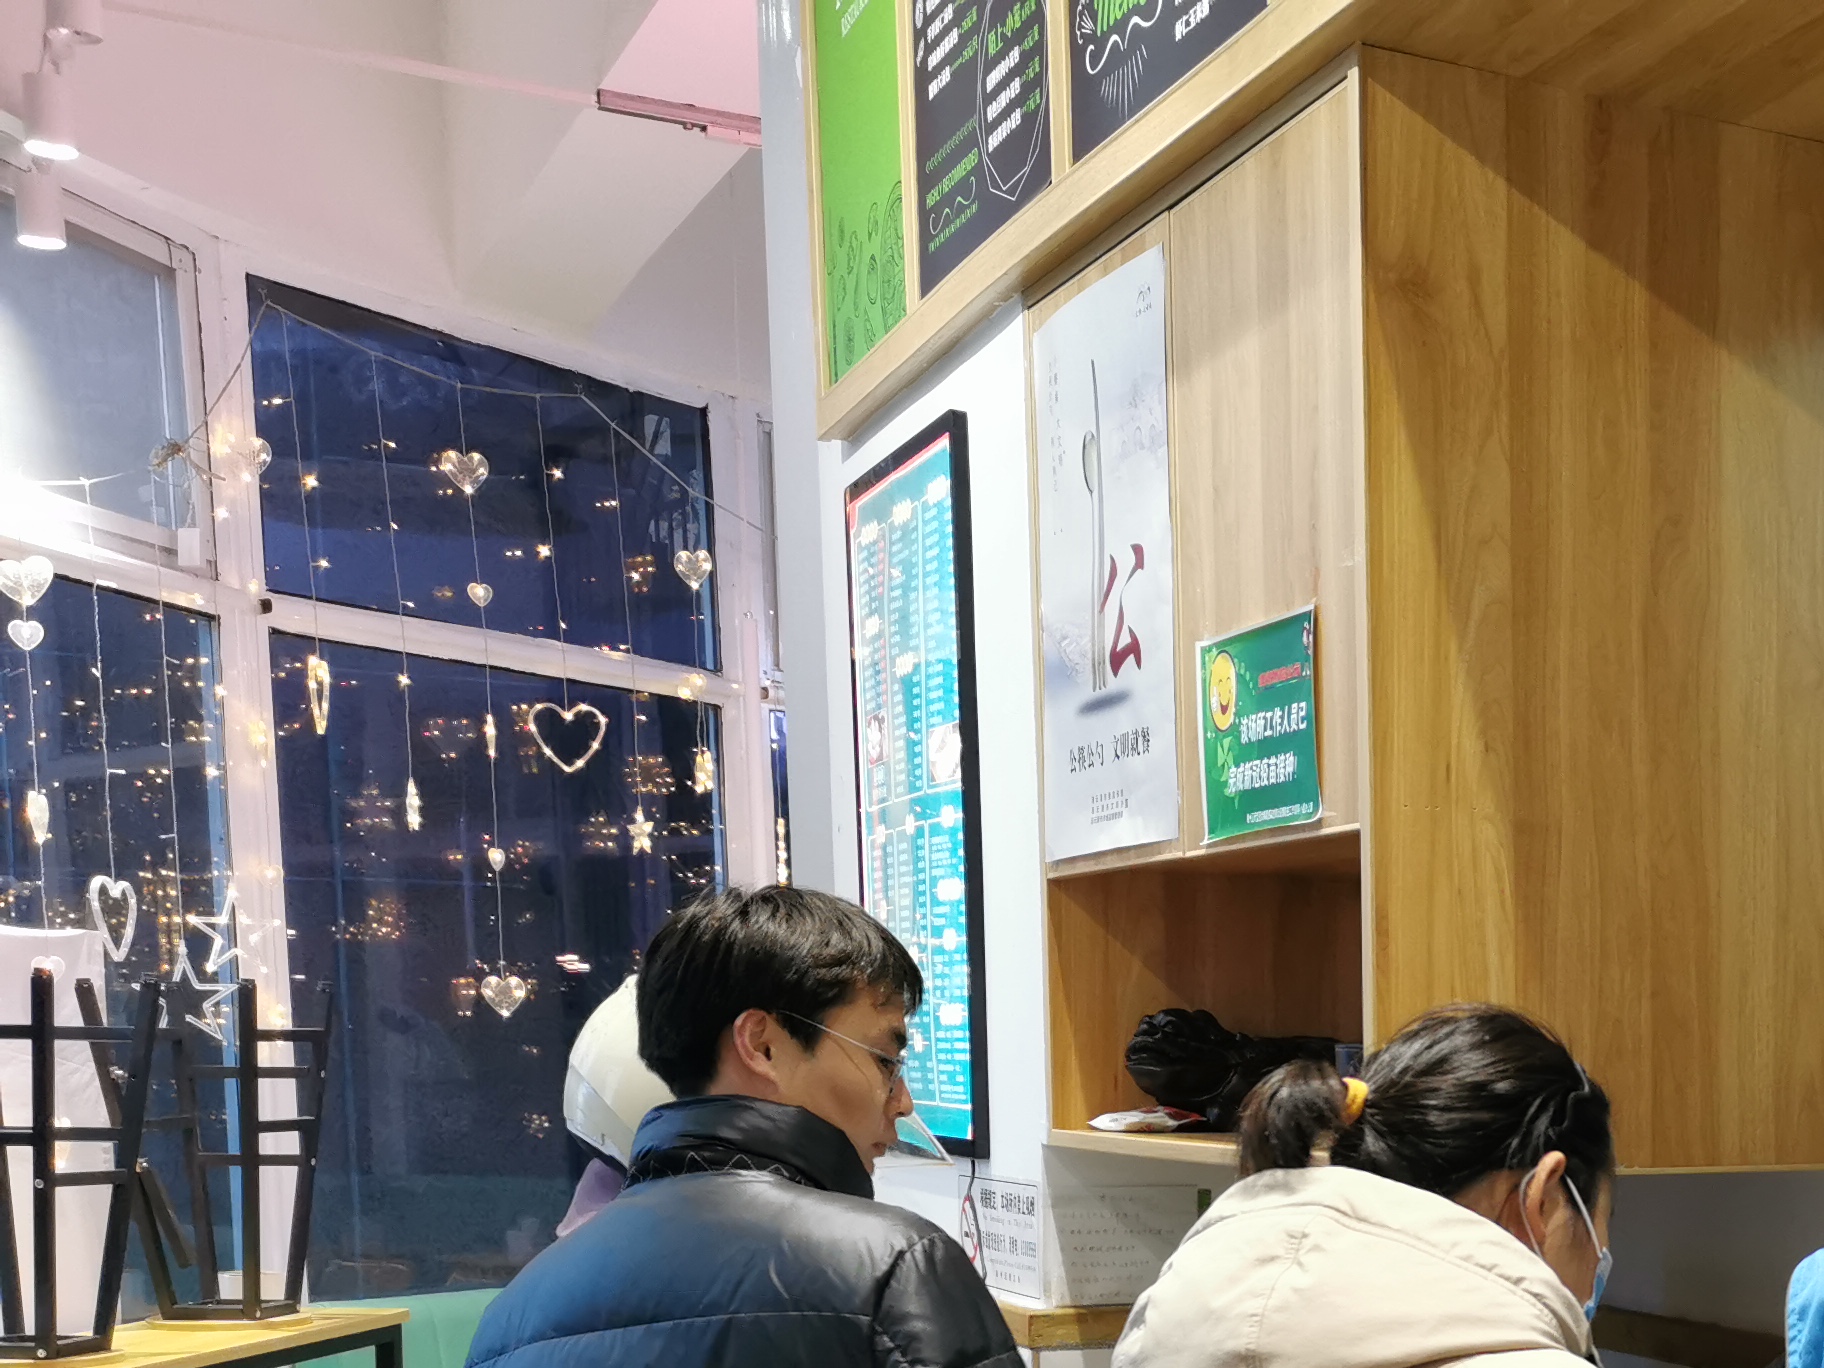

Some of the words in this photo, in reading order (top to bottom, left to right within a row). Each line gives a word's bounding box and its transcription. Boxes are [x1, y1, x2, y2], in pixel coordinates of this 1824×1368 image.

[926, 184, 941, 210] HIGHLY
[942, 148, 978, 195] RECOMMENDED
[1238, 701, 1308, 745] 该场所工作人员已
[1068, 738, 1105, 777] 公筷公勺
[1110, 726, 1152, 764] 文明就餐
